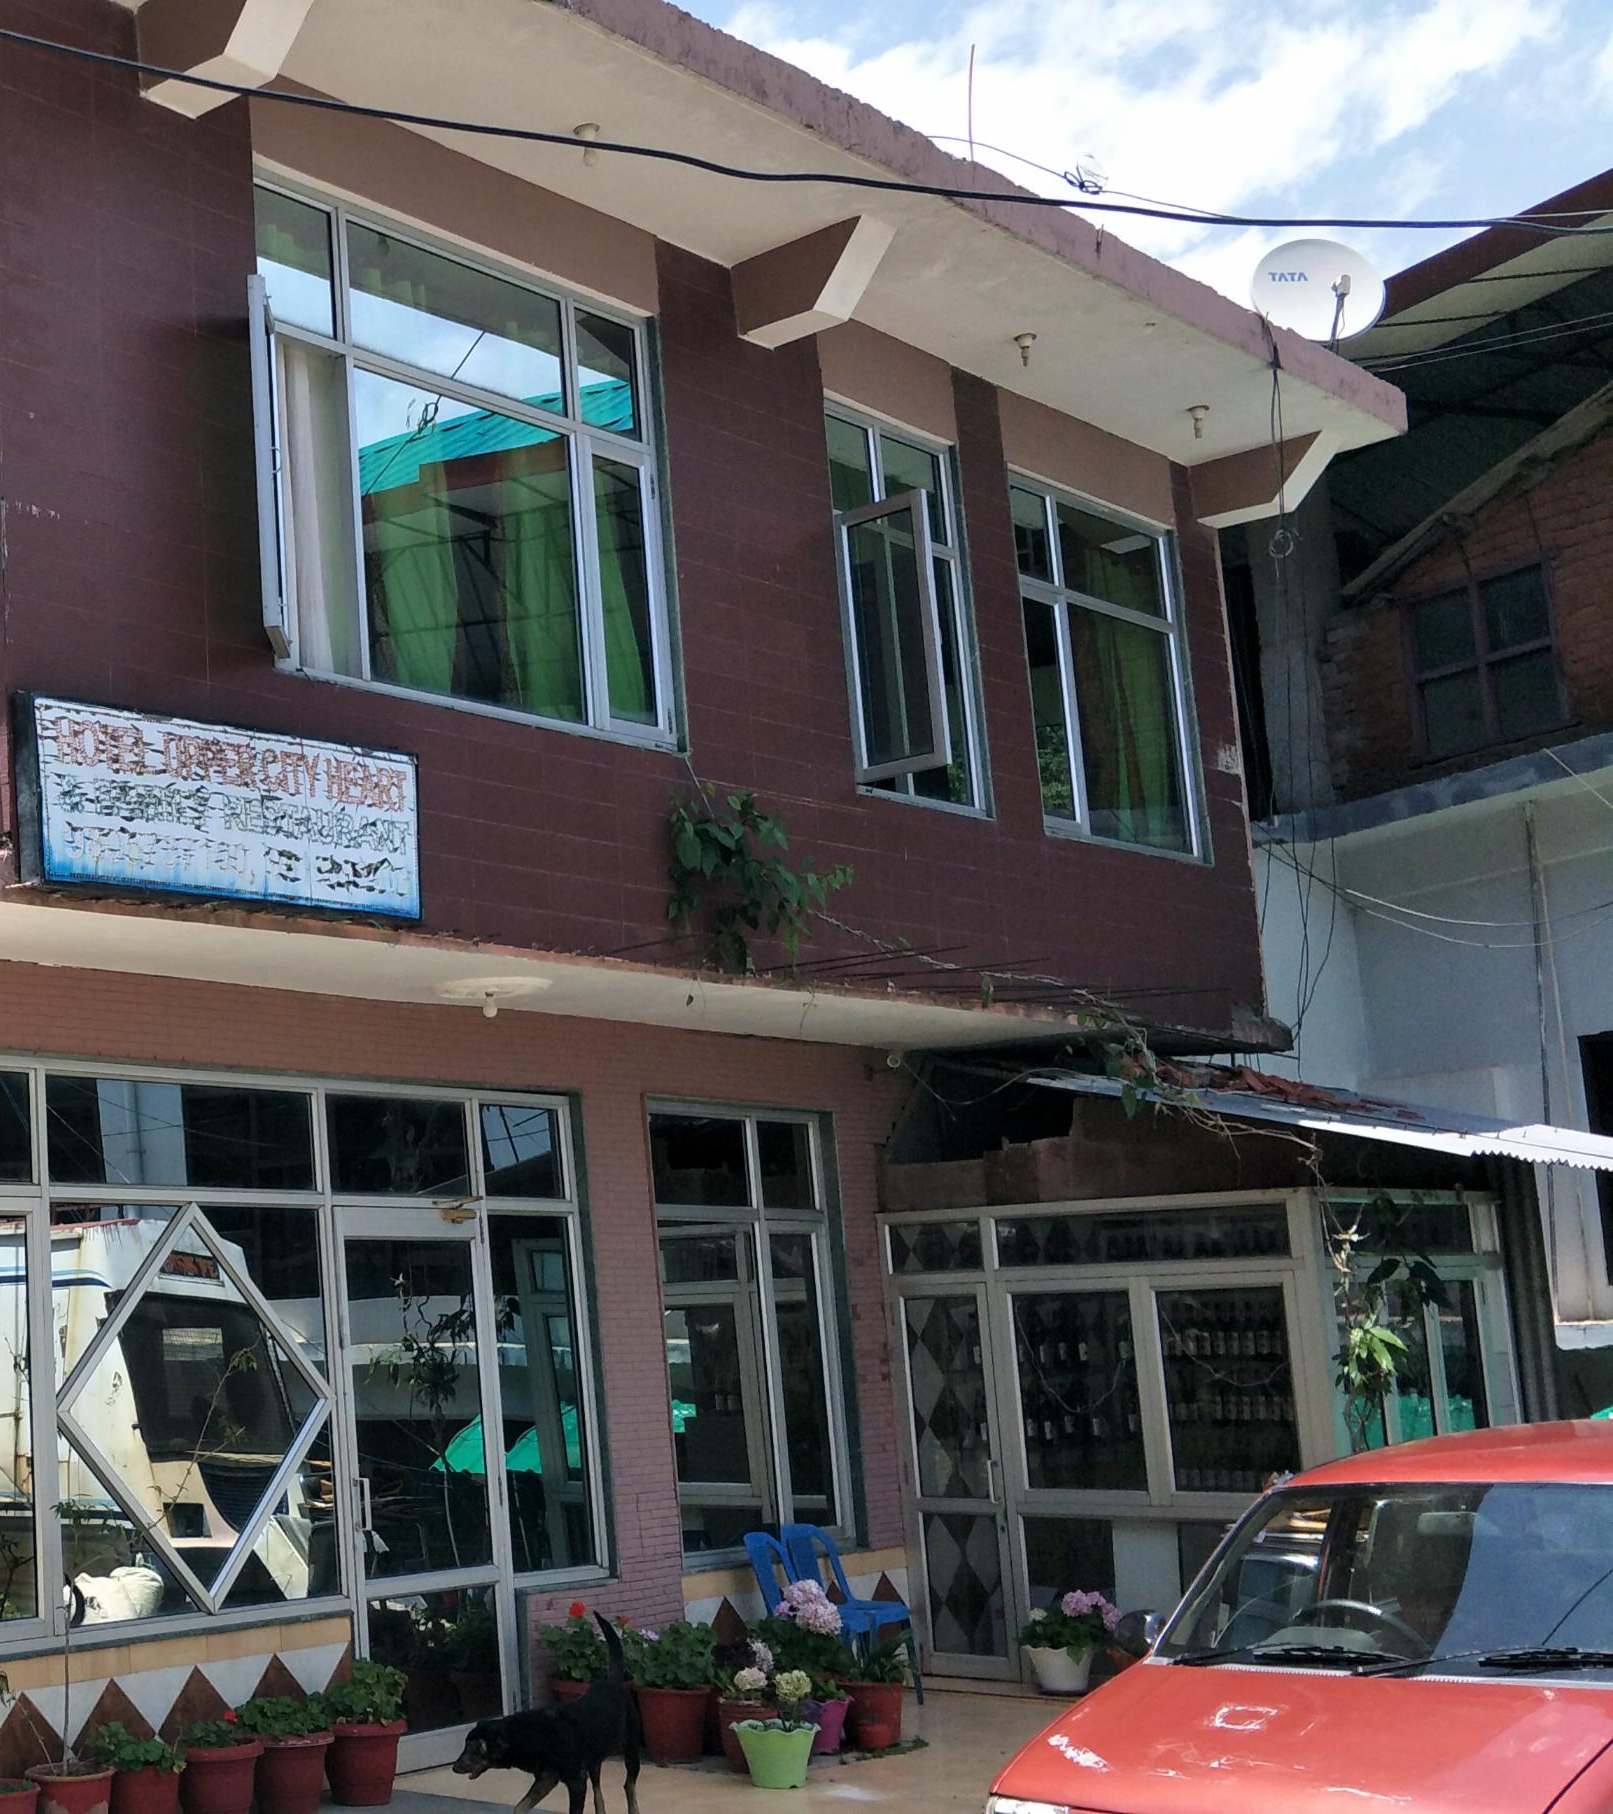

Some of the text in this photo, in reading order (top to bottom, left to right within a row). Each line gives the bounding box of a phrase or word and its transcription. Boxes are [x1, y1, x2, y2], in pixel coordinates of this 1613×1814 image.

[1268, 271, 1309, 283] TATA
[54, 715, 156, 775] HOTEL
[258, 748, 321, 798] CITY
[325, 756, 406, 812] HEART
[223, 795, 410, 855] RESTAURANT
